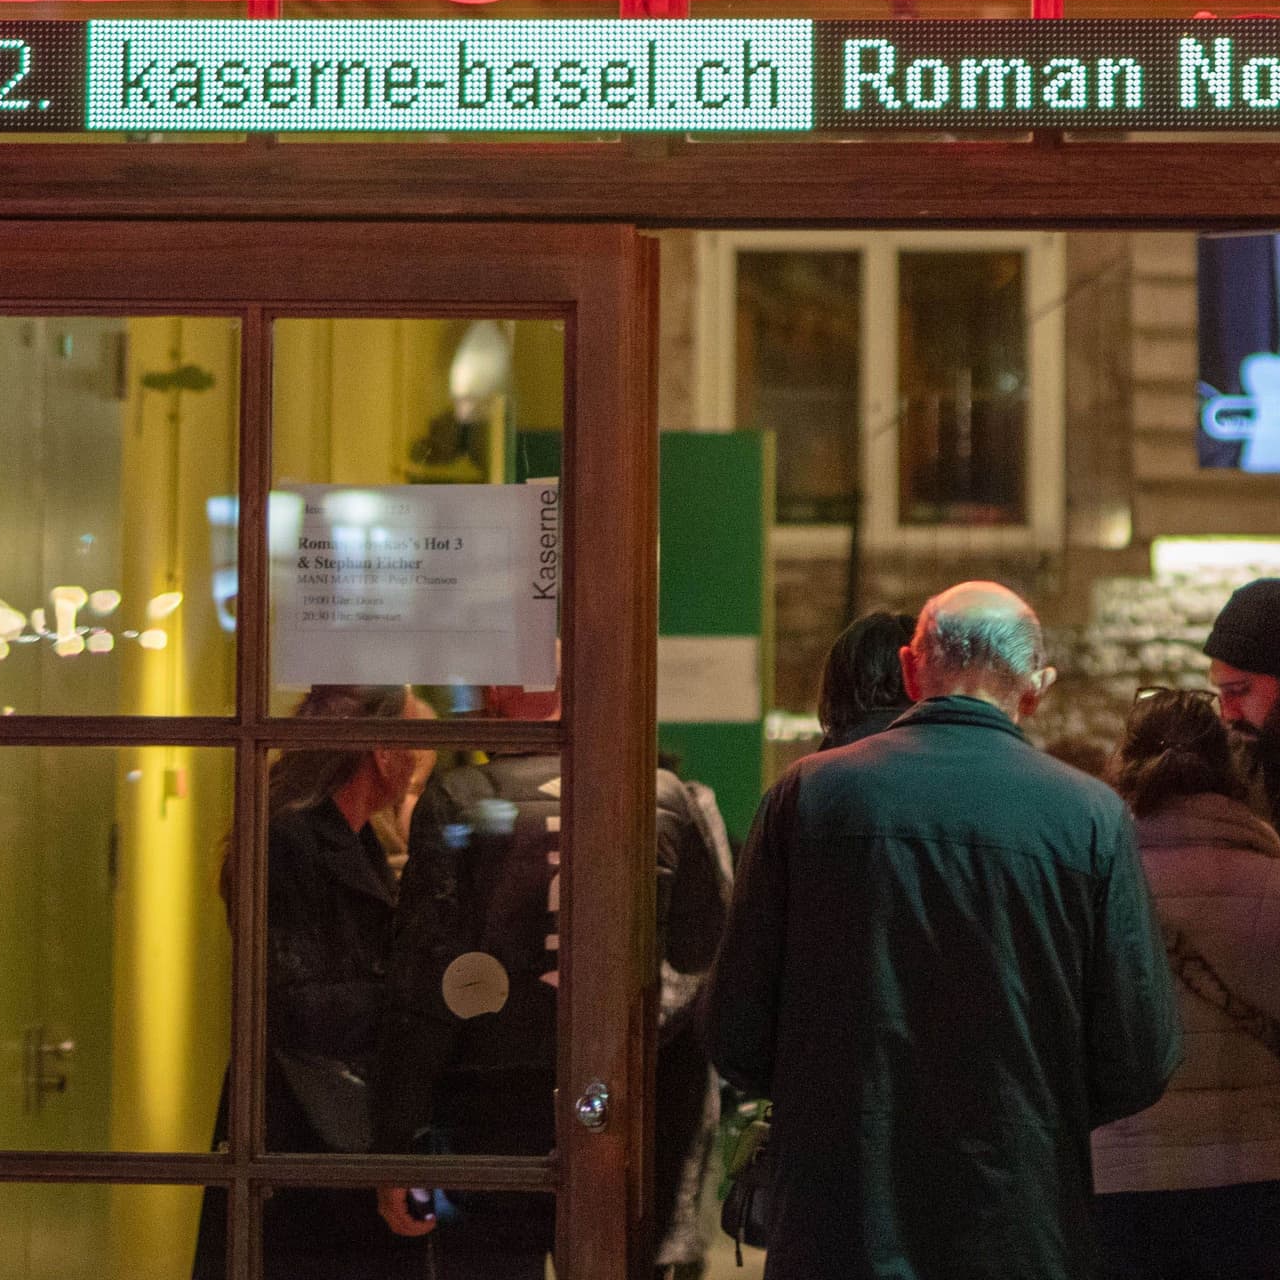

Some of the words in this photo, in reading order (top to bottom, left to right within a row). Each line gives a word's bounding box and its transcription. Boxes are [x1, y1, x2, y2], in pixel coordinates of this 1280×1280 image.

[120, 40, 777, 108] kaserne-basel.ch
[842, 38, 1144, 111] Roman
[425, 538, 449, 550] Hot
[455, 538, 463, 550] 3
[533, 490, 559, 600] Kaserne
[298, 557, 310, 568] &
[314, 557, 371, 569] Stephan
[378, 557, 423, 569] Eicher
[298, 576, 328, 584] MANI
[416, 576, 457, 585] Chanson
